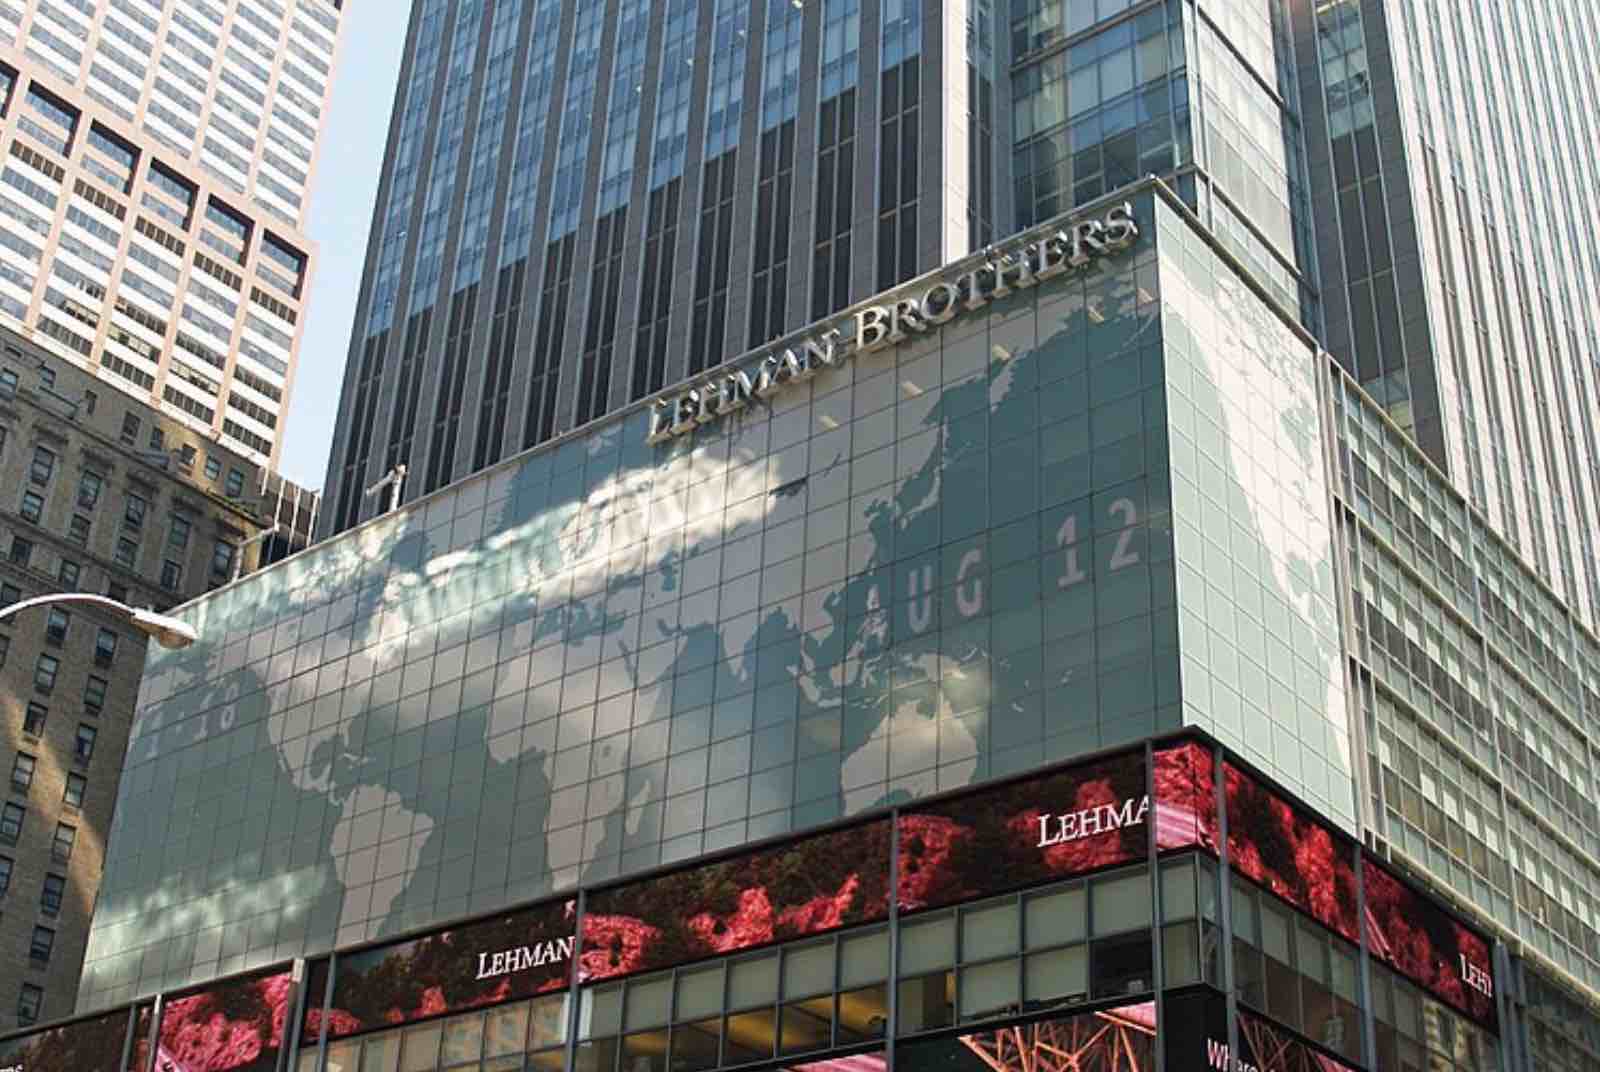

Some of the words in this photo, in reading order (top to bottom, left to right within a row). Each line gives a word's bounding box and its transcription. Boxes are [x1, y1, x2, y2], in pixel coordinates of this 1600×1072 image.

[647, 330, 841, 446] LEHMAN
[853, 201, 1138, 351] BROTHERS
[1056, 498, 1139, 588] 12
[475, 935, 576, 980] LEHMAN
